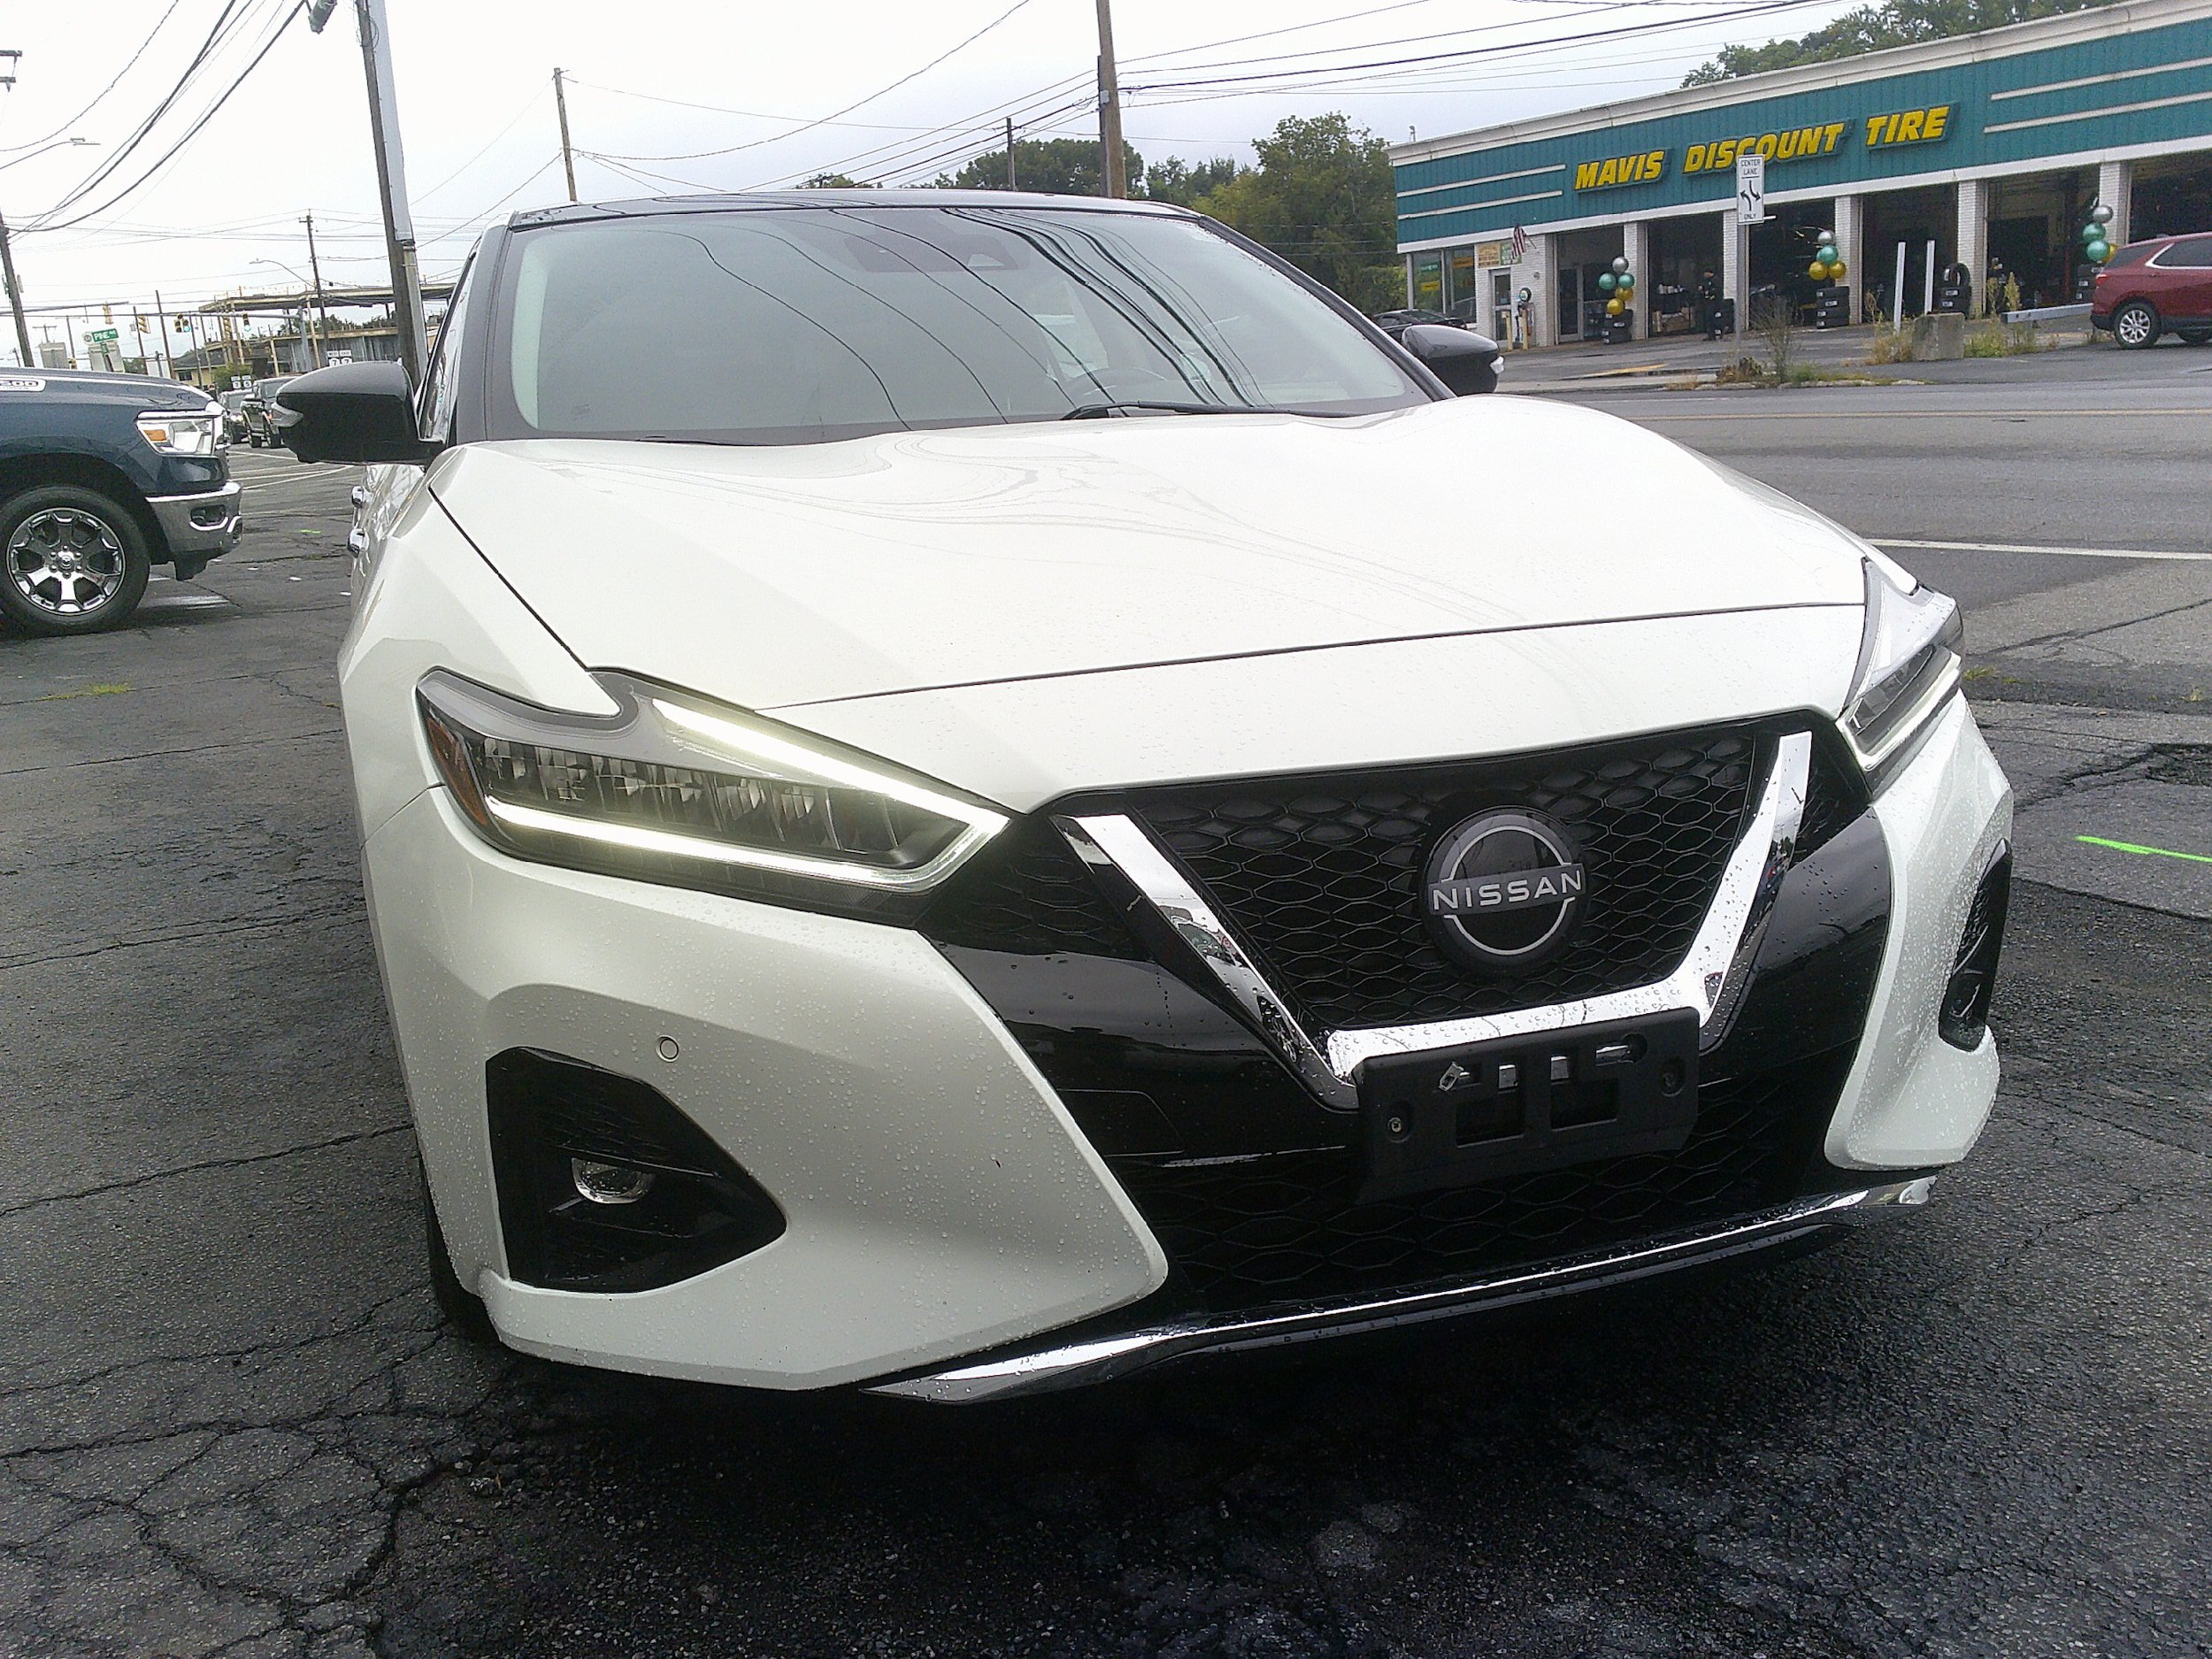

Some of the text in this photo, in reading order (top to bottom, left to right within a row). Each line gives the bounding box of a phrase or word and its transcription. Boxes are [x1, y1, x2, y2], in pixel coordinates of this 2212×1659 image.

[1574, 105, 1951, 190] MAVIS DISCOUNT TIRE
[1432, 870, 1582, 910] NISSAN
